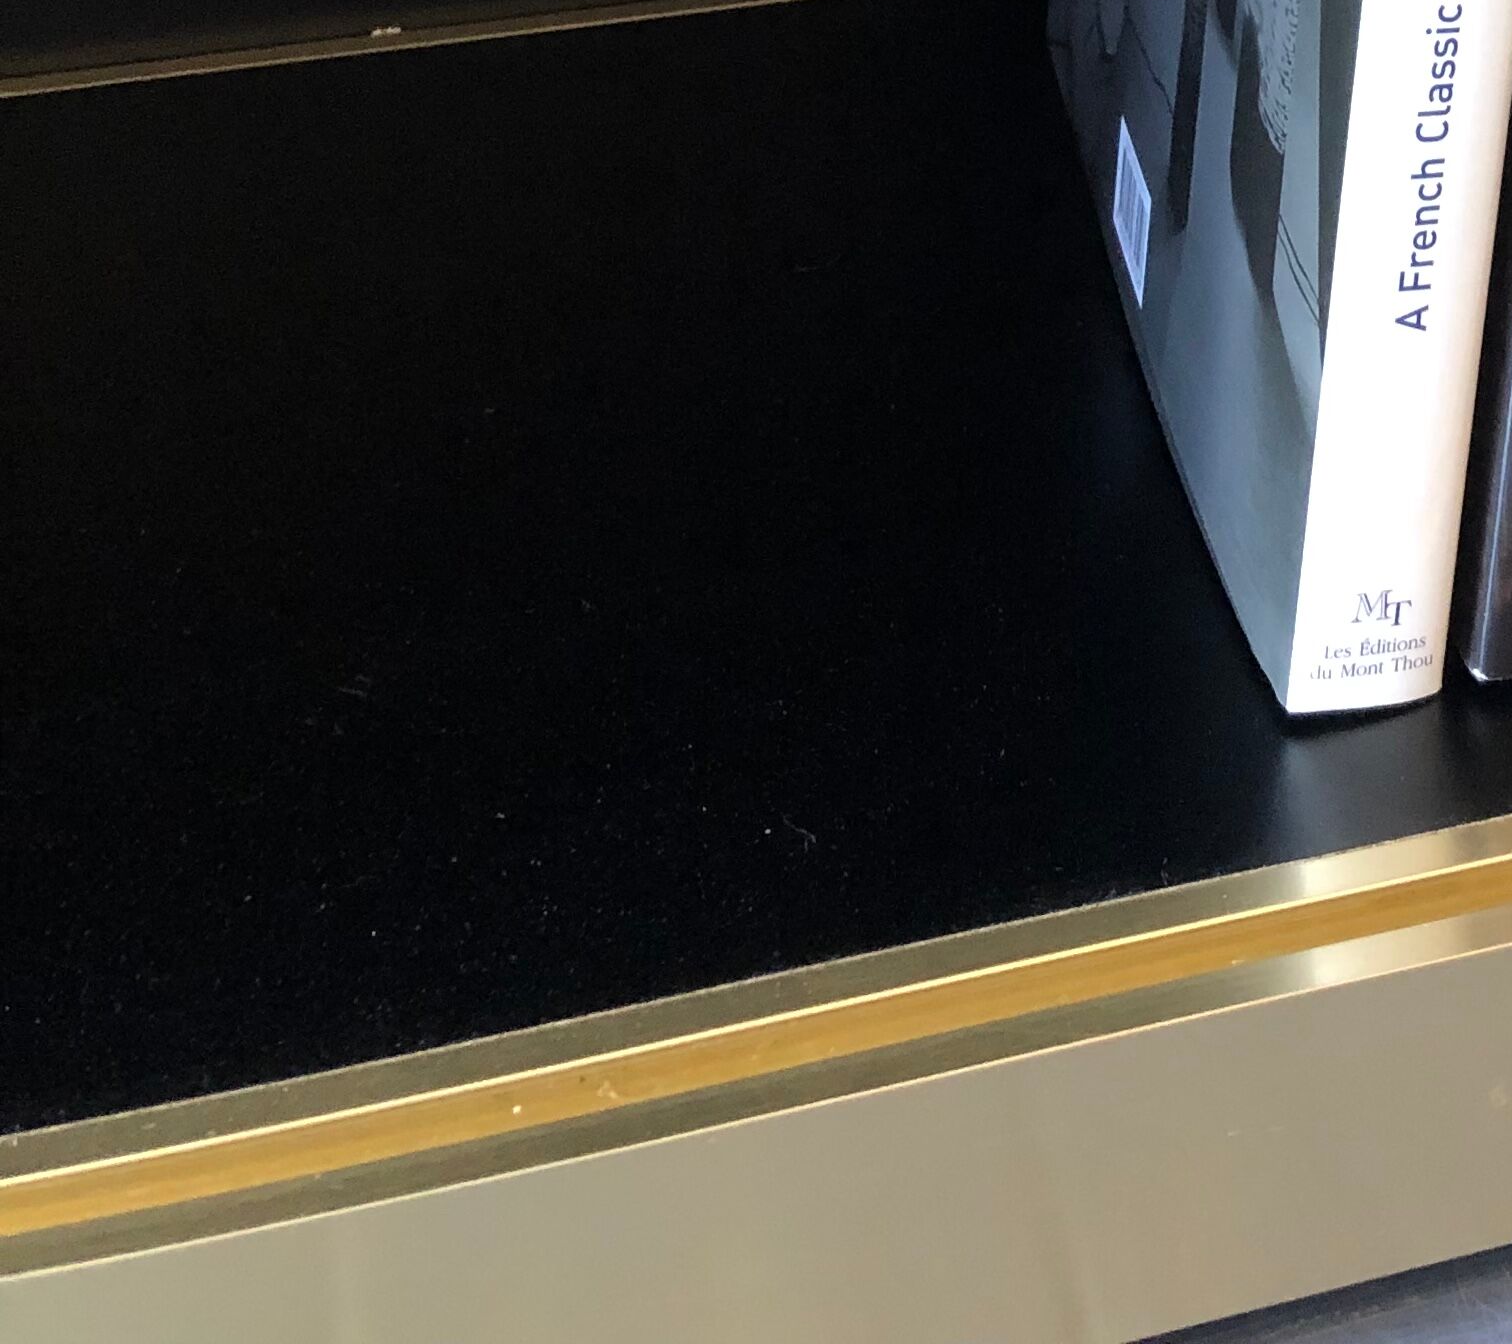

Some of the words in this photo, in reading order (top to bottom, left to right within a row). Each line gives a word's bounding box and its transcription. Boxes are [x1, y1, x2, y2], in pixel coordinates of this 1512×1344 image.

[1415, 3, 1463, 143] Classic
[1399, 157, 1446, 293] French
[1395, 303, 1427, 331] A
[1324, 646, 1351, 659] Les
[1360, 636, 1427, 656] Éditions
[1310, 665, 1332, 679] du
[1340, 662, 1384, 678] Mont
[1391, 654, 1434, 673] Thou
